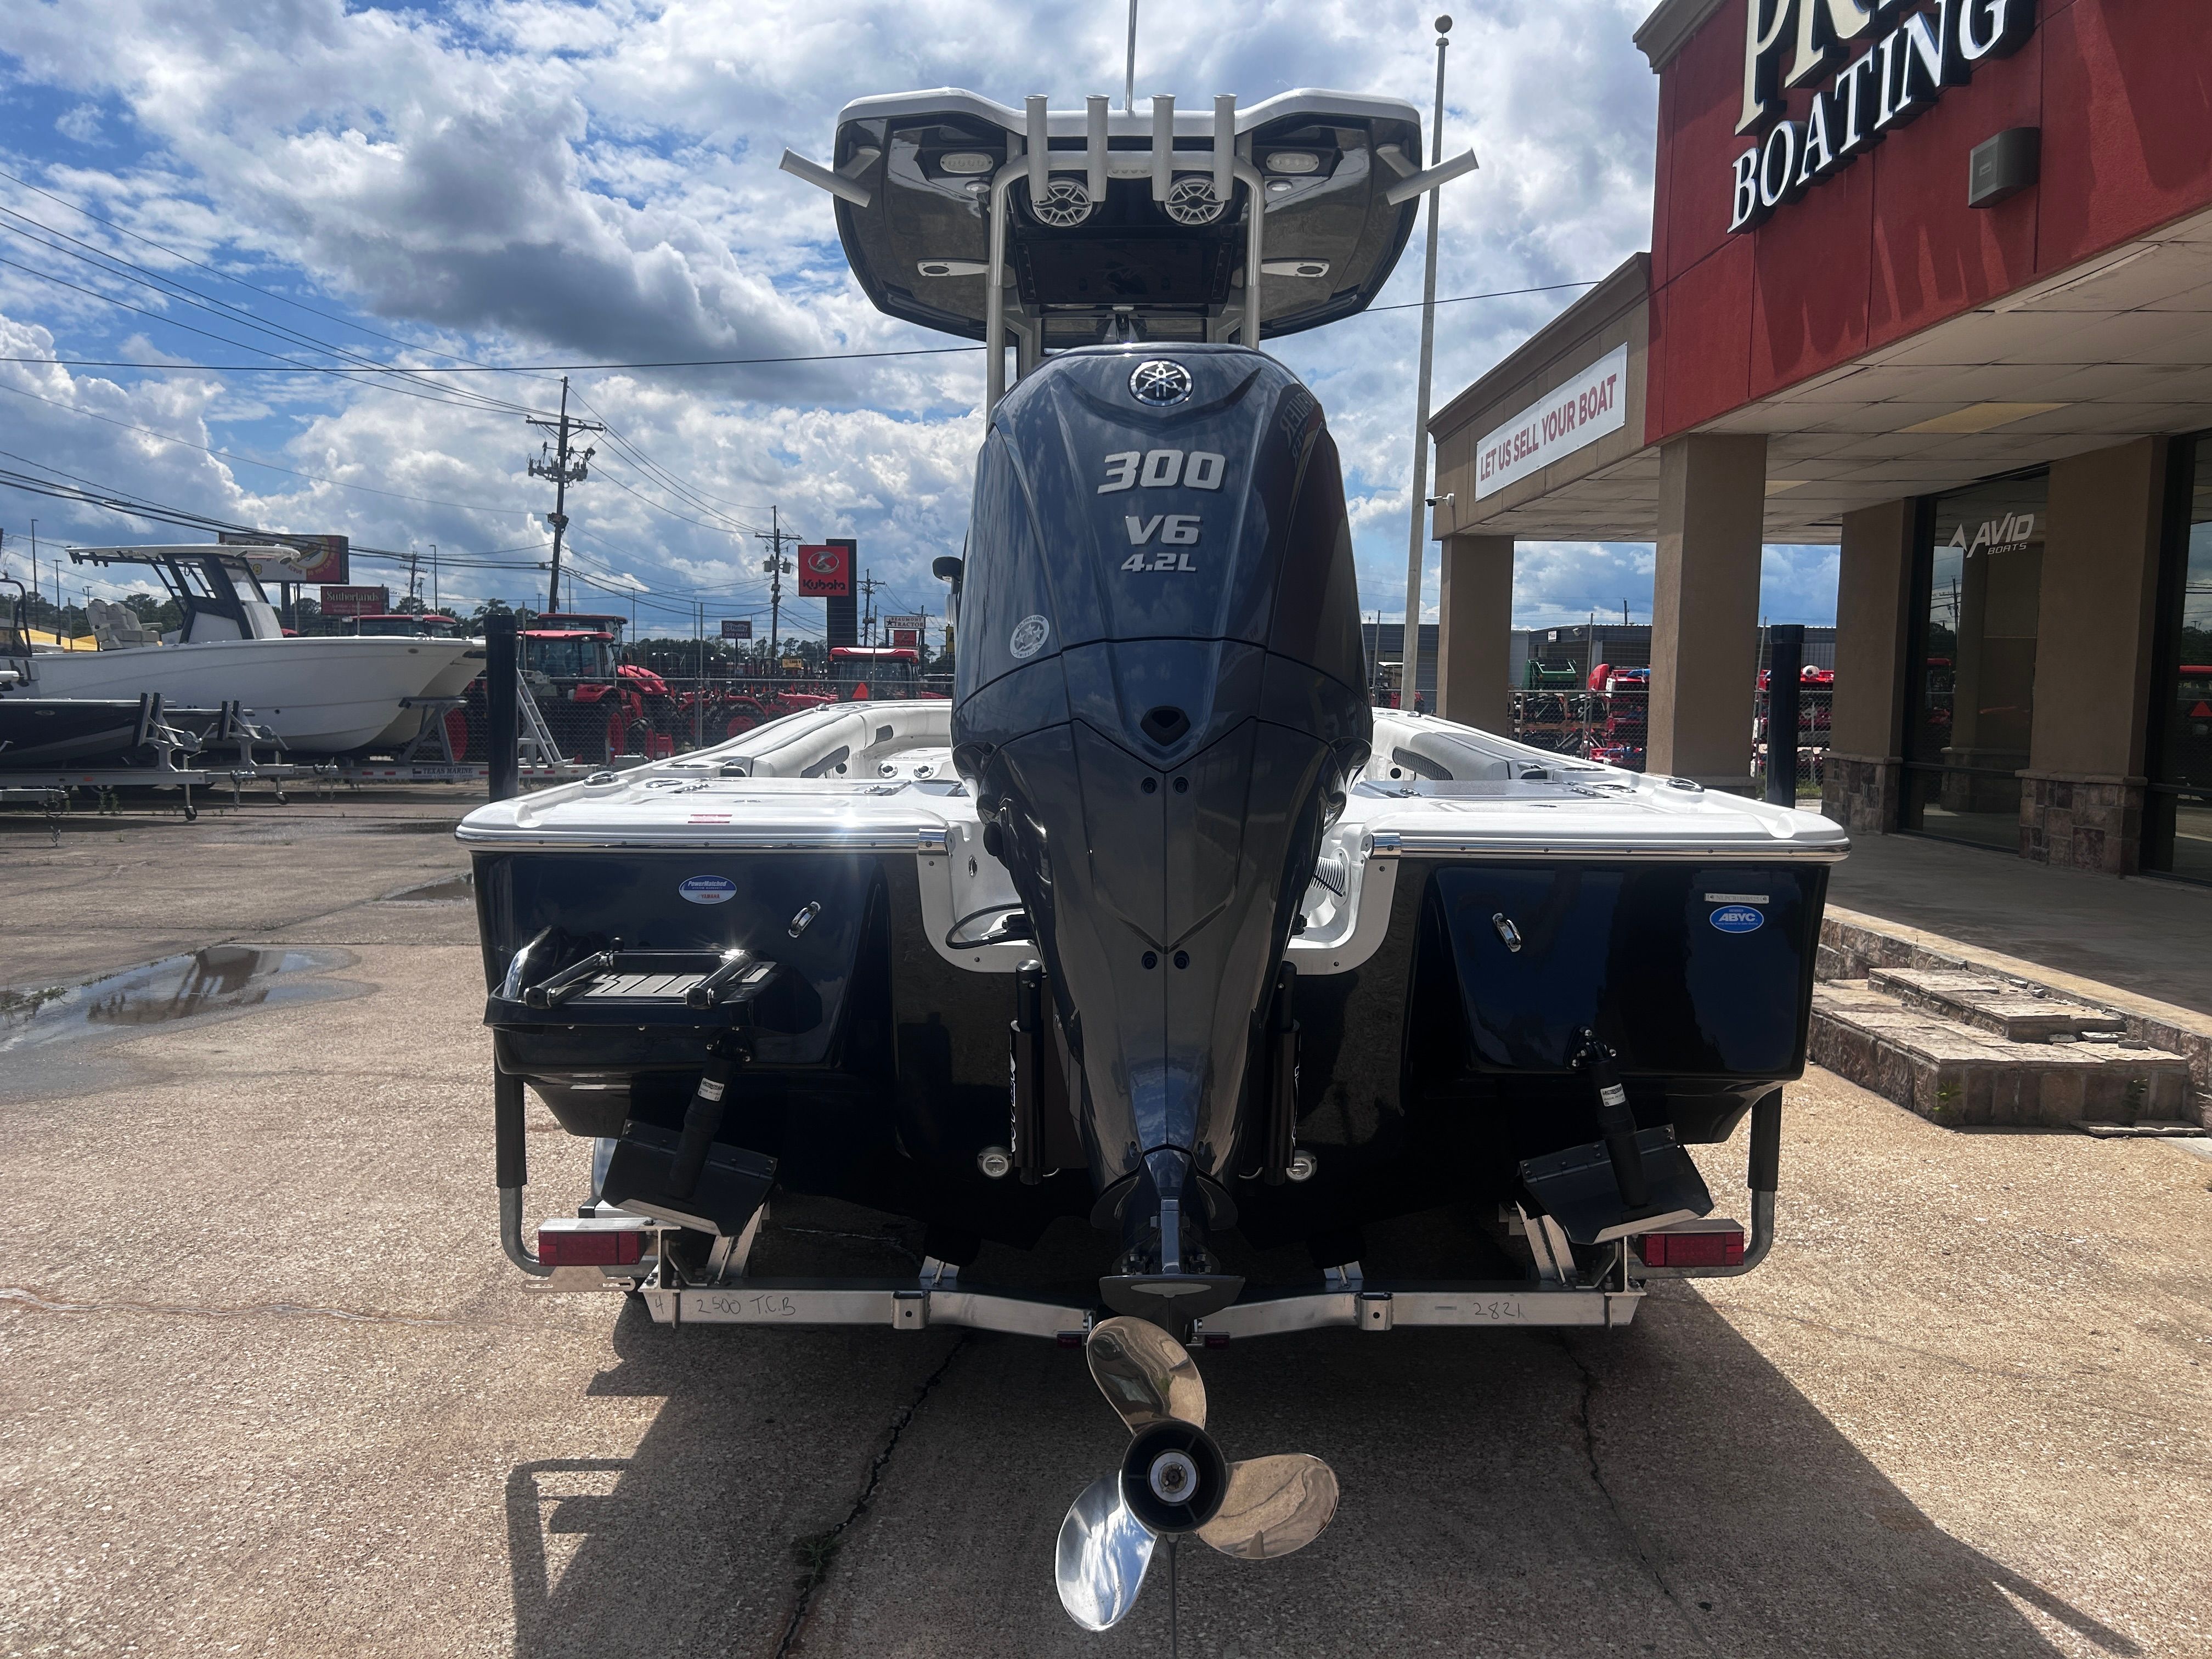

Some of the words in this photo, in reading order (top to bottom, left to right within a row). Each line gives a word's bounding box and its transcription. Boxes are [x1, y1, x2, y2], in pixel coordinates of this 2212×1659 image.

[1728, 0, 2009, 234] BOATING
[1481, 448, 1497, 481] LET
[1498, 439, 1511, 470] US
[1514, 424, 1539, 462] SELL
[1542, 400, 1575, 445] YOUR
[1579, 373, 1617, 425] BOAT
[1098, 449, 1226, 494] 300
[1125, 515, 1201, 545] V6
[1966, 512, 2035, 558] AVID
[1988, 542, 2028, 555] BOATS
[1120, 553, 1197, 573] 4.2L
[803, 579, 845, 590] Kubota
[326, 591, 379, 602] Sutherlands
[1718, 913, 1756, 922] ABYC
[655, 1295, 664, 1314] 4
[696, 1296, 741, 1314] 2500
[1473, 1302, 1522, 1319] 2821
